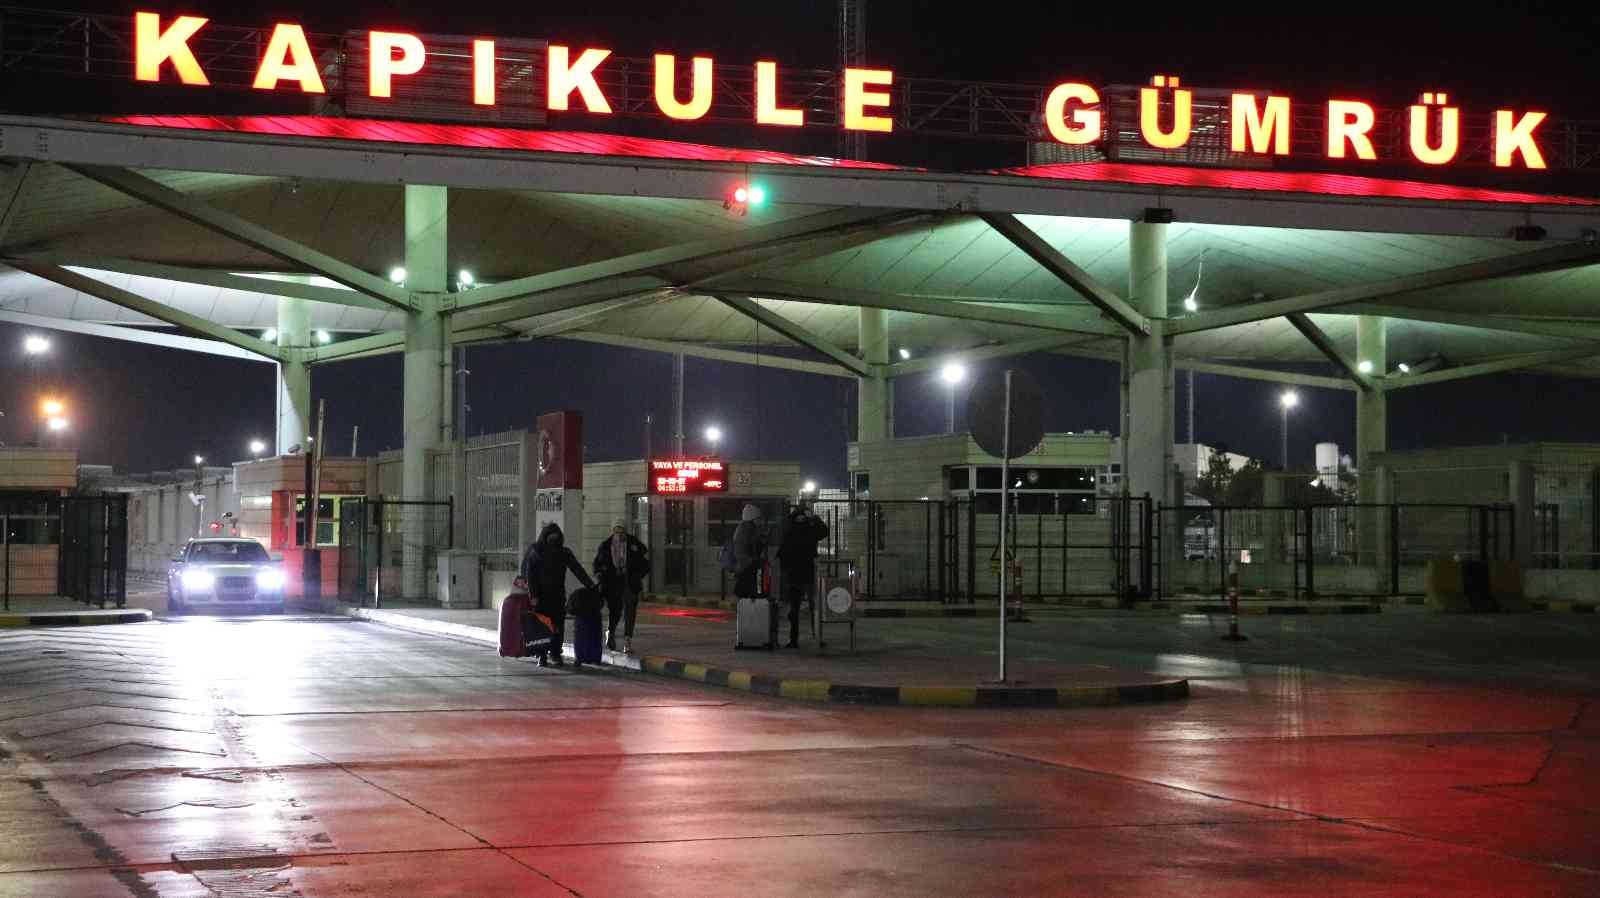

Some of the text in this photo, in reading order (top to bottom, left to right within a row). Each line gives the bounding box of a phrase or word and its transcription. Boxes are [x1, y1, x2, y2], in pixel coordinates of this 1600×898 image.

[133, 11, 1549, 170] KAPIKULE GÜMRÜK
[653, 461, 672, 469] YAYA
